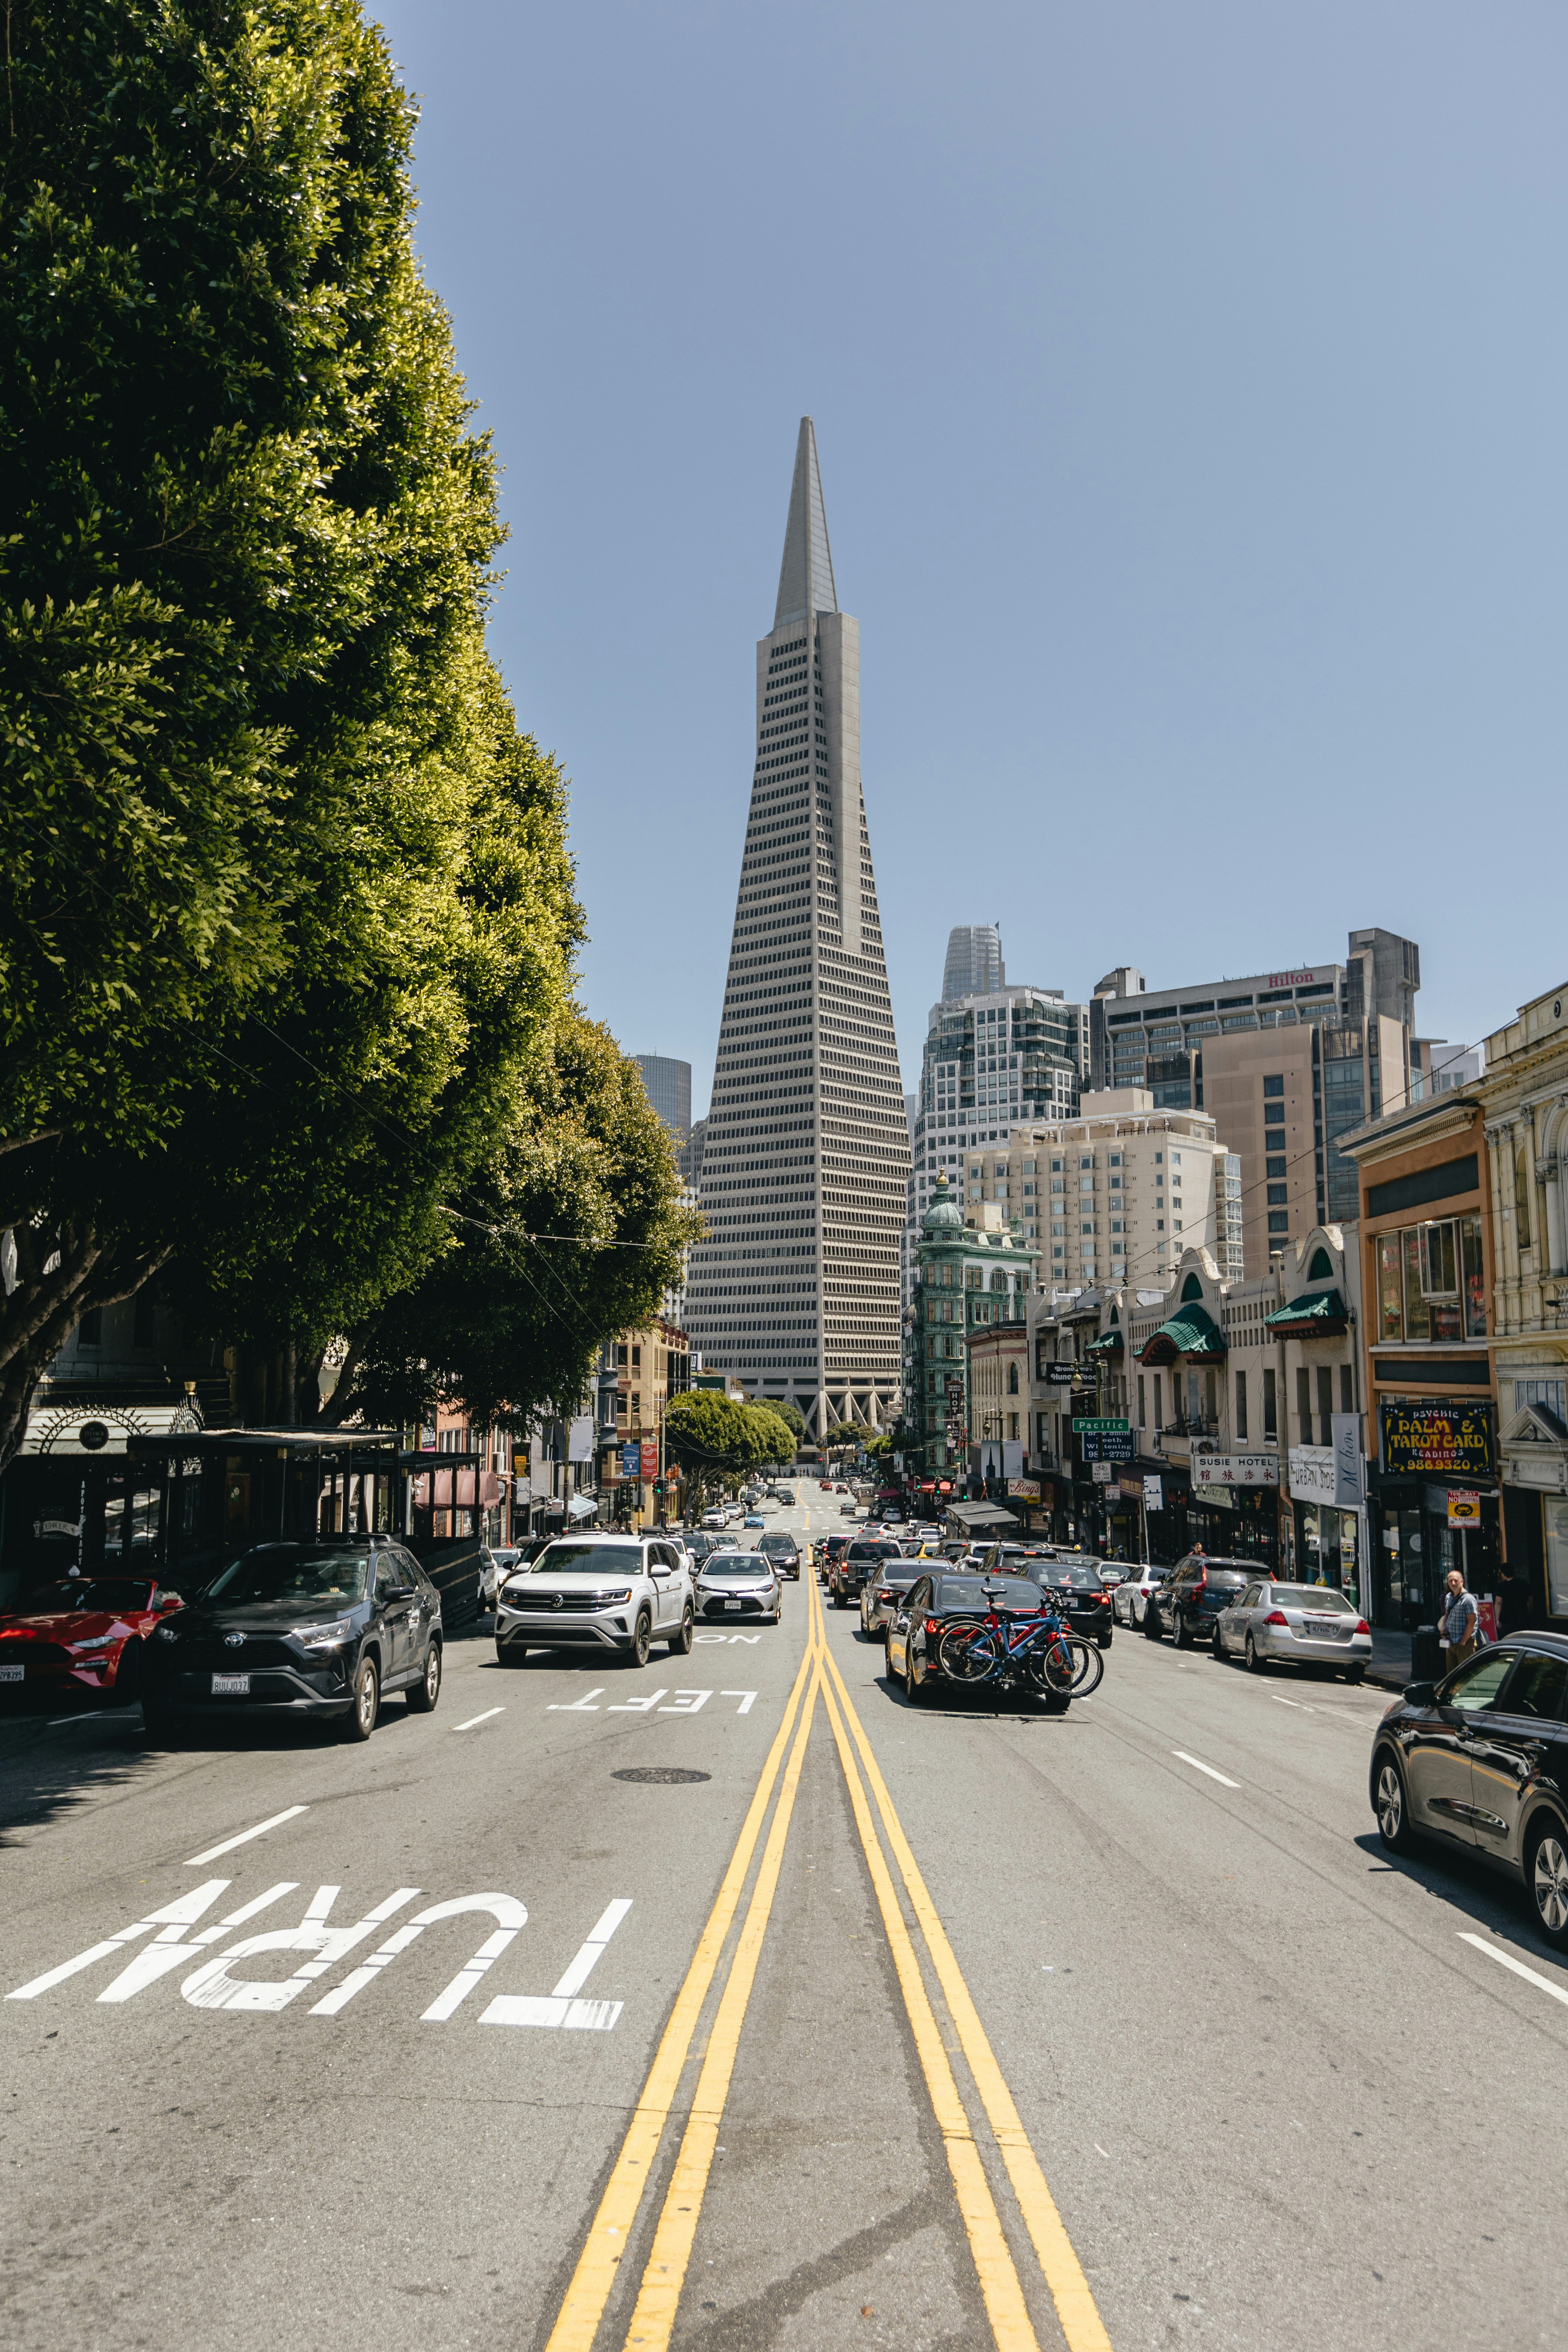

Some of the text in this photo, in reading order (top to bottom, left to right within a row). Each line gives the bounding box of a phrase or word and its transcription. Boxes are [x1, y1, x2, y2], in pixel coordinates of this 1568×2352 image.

[1268, 973, 1314, 988] Hilton
[1413, 1409, 1459, 1419] PSYCHIC
[1398, 1420, 1474, 1433] PALM &
[1391, 1434, 1484, 1448] TAROT CARD
[1412, 1449, 1464, 1458] READINGS
[1296, 1468, 1334, 1490] URBAN SIDE
[1011, 1480, 1040, 1496] Bing's
[215, 1681, 247, 1691] 8UUJ037
[546, 1688, 759, 1714] LEFT
[2, 1879, 634, 2030] TURN
